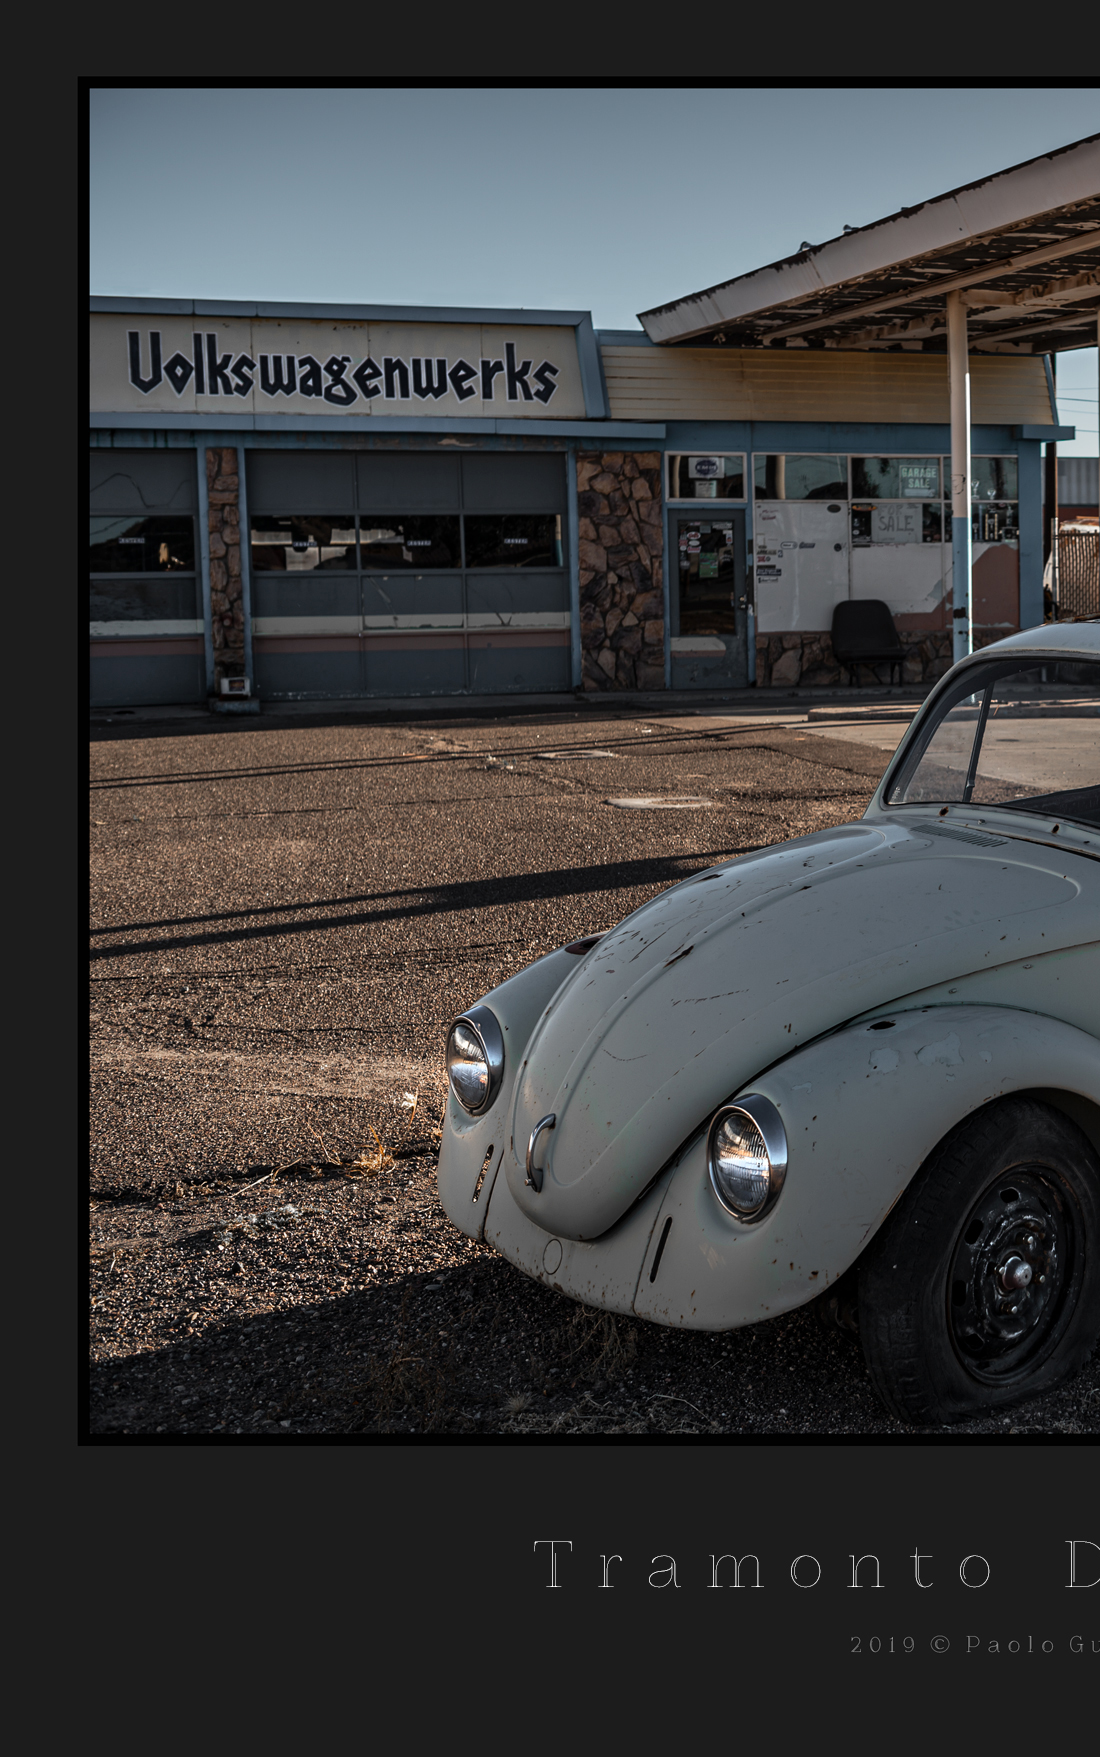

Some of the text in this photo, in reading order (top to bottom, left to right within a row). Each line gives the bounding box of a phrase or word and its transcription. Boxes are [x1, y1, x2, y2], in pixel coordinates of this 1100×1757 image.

[127, 330, 560, 406] Volkswagenwerks
[901, 467, 937, 478] GARAGE
[908, 478, 930, 488] SALE
[878, 504, 903, 516] FOR
[878, 515, 915, 532] SALE
